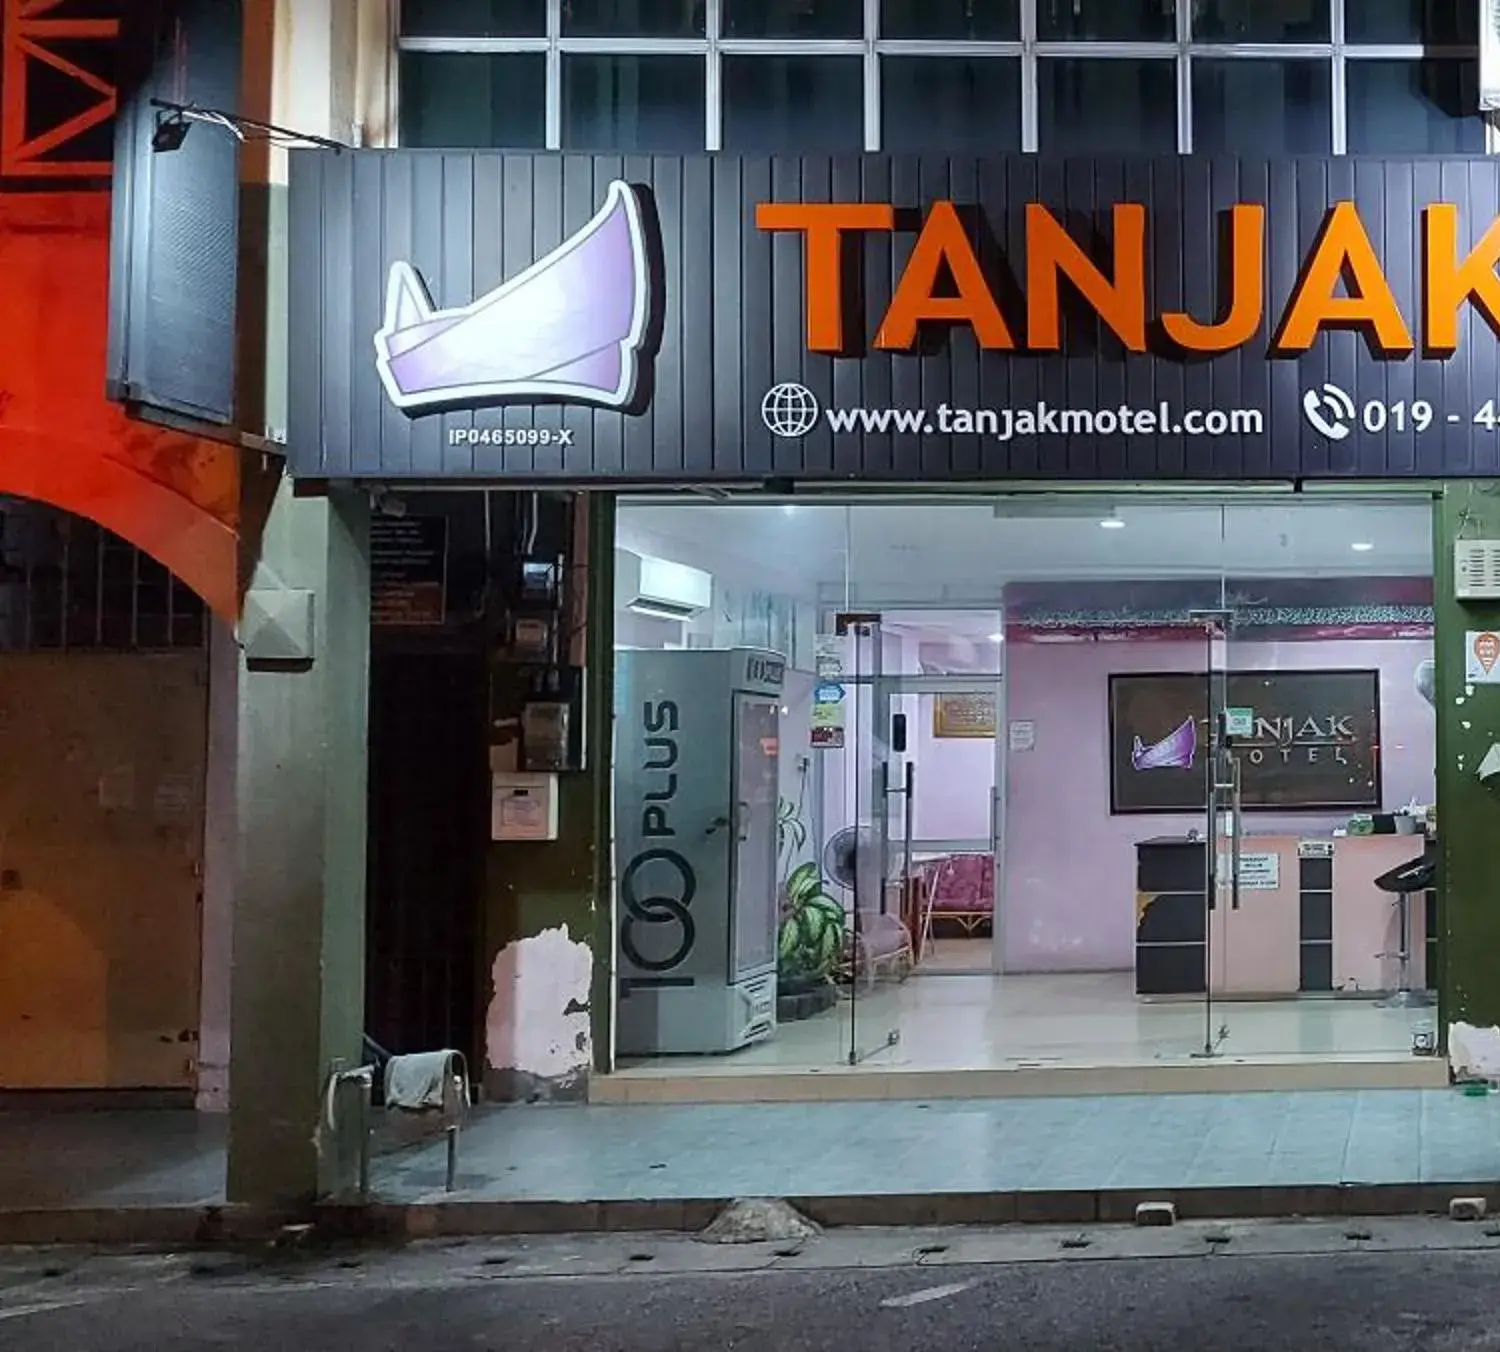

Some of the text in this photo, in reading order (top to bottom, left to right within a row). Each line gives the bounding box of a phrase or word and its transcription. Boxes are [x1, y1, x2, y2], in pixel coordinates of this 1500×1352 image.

[825, 401, 1264, 440] www.tanjakmotel.com
[1363, 400, 1433, 432] 019
[1447, 414, 1460, 422] -
[449, 429, 573, 445] IP0465099-X
